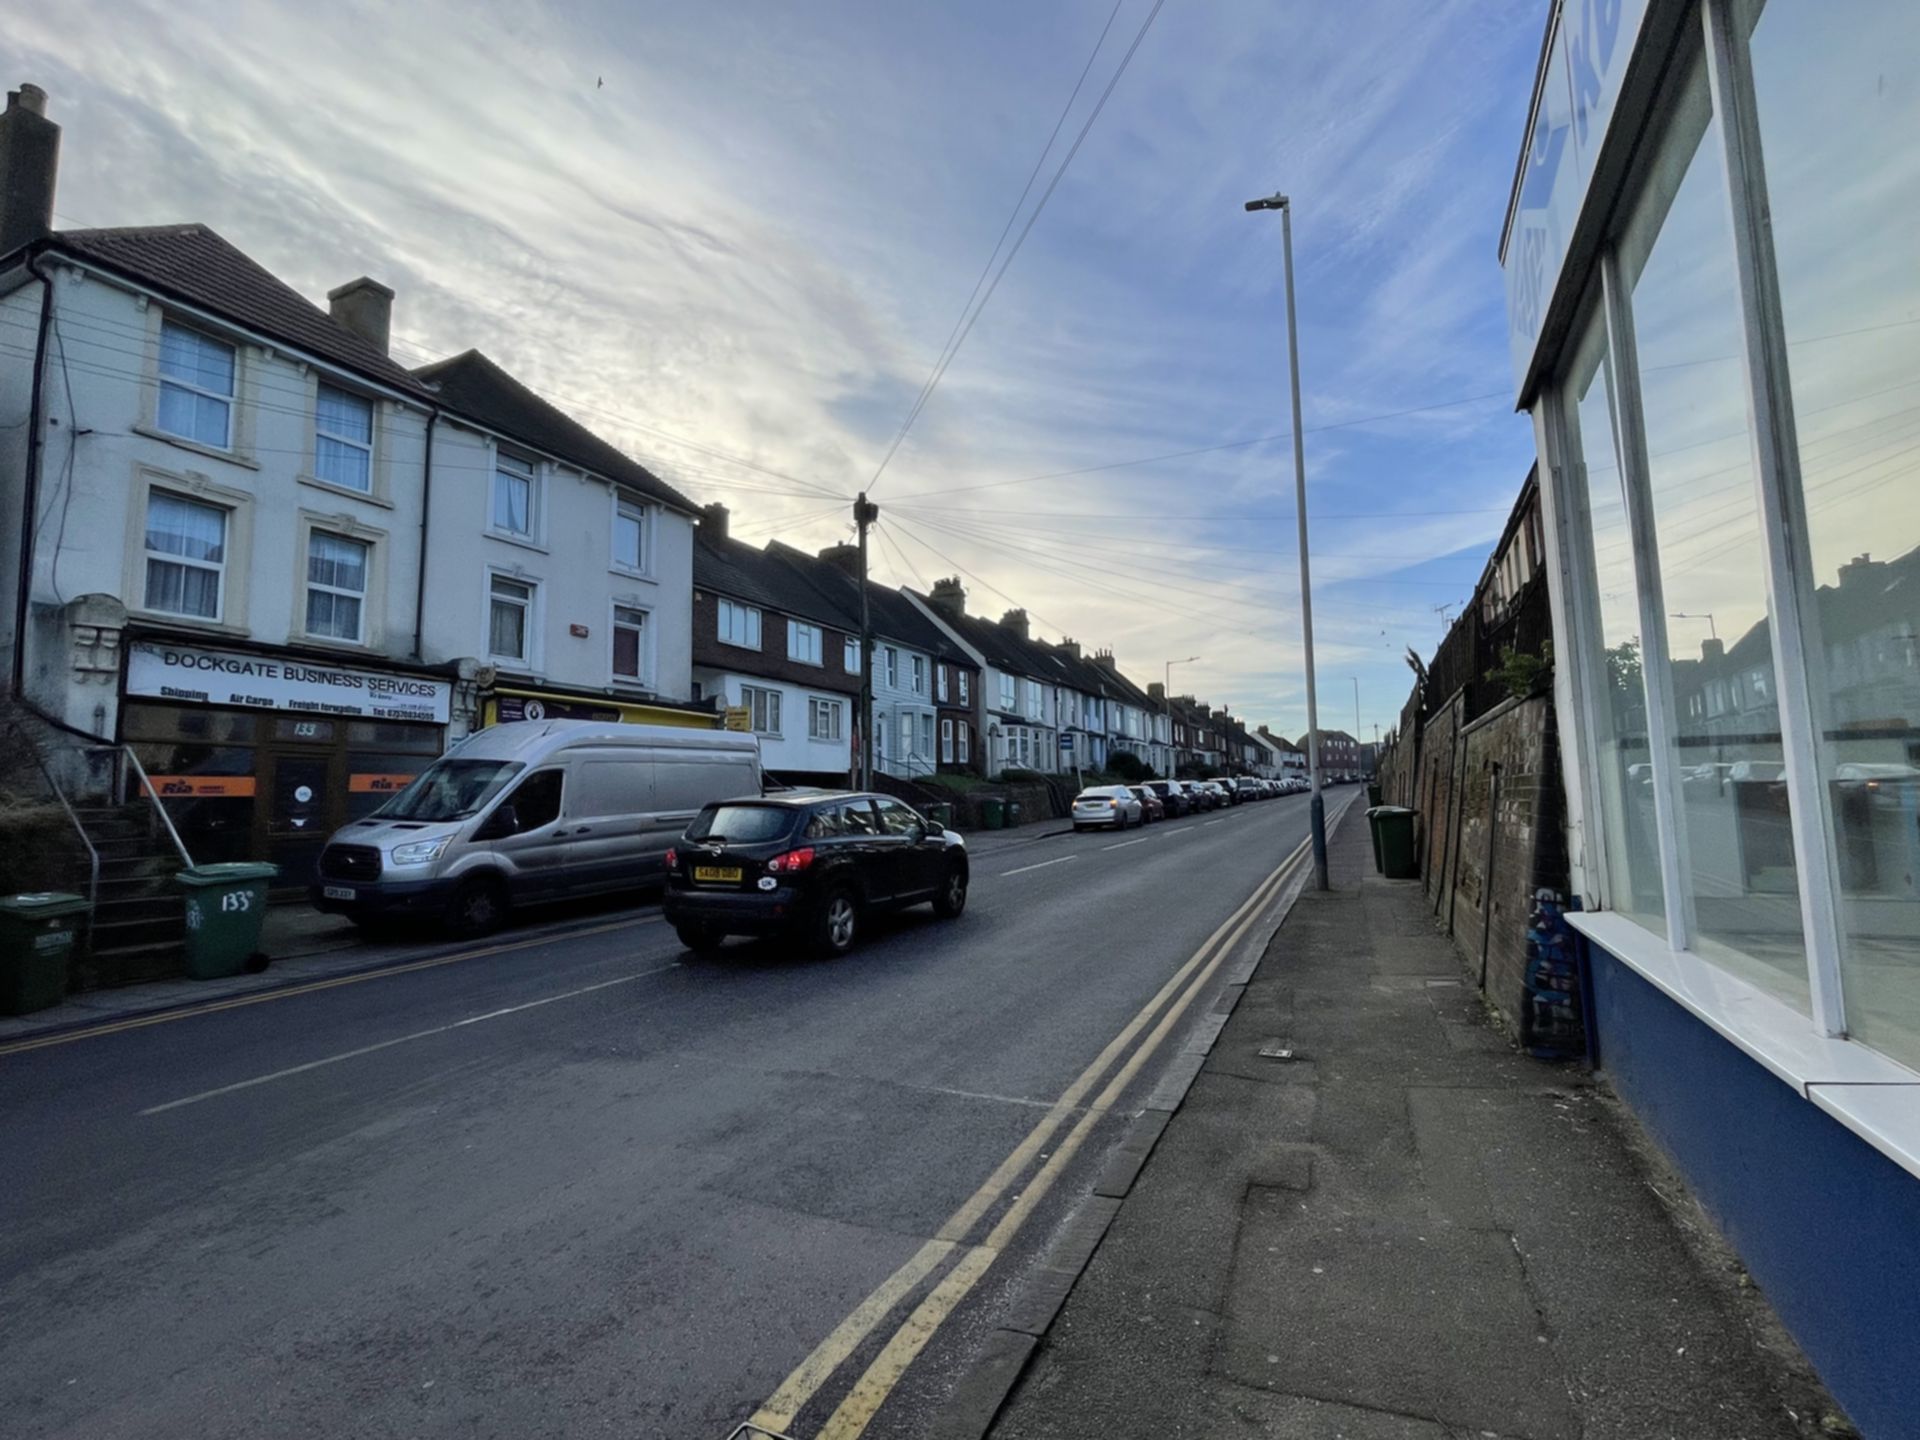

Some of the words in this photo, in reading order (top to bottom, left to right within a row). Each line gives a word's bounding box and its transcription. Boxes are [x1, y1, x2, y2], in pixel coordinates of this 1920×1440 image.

[164, 651, 278, 678] DOCKGATE
[283, 666, 363, 689] BUSINESS
[367, 677, 436, 697] SERVICES
[160, 686, 209, 702] Shipping
[229, 693, 243, 704] Air
[245, 695, 274, 706] Cargo
[294, 723, 317, 736] 133
